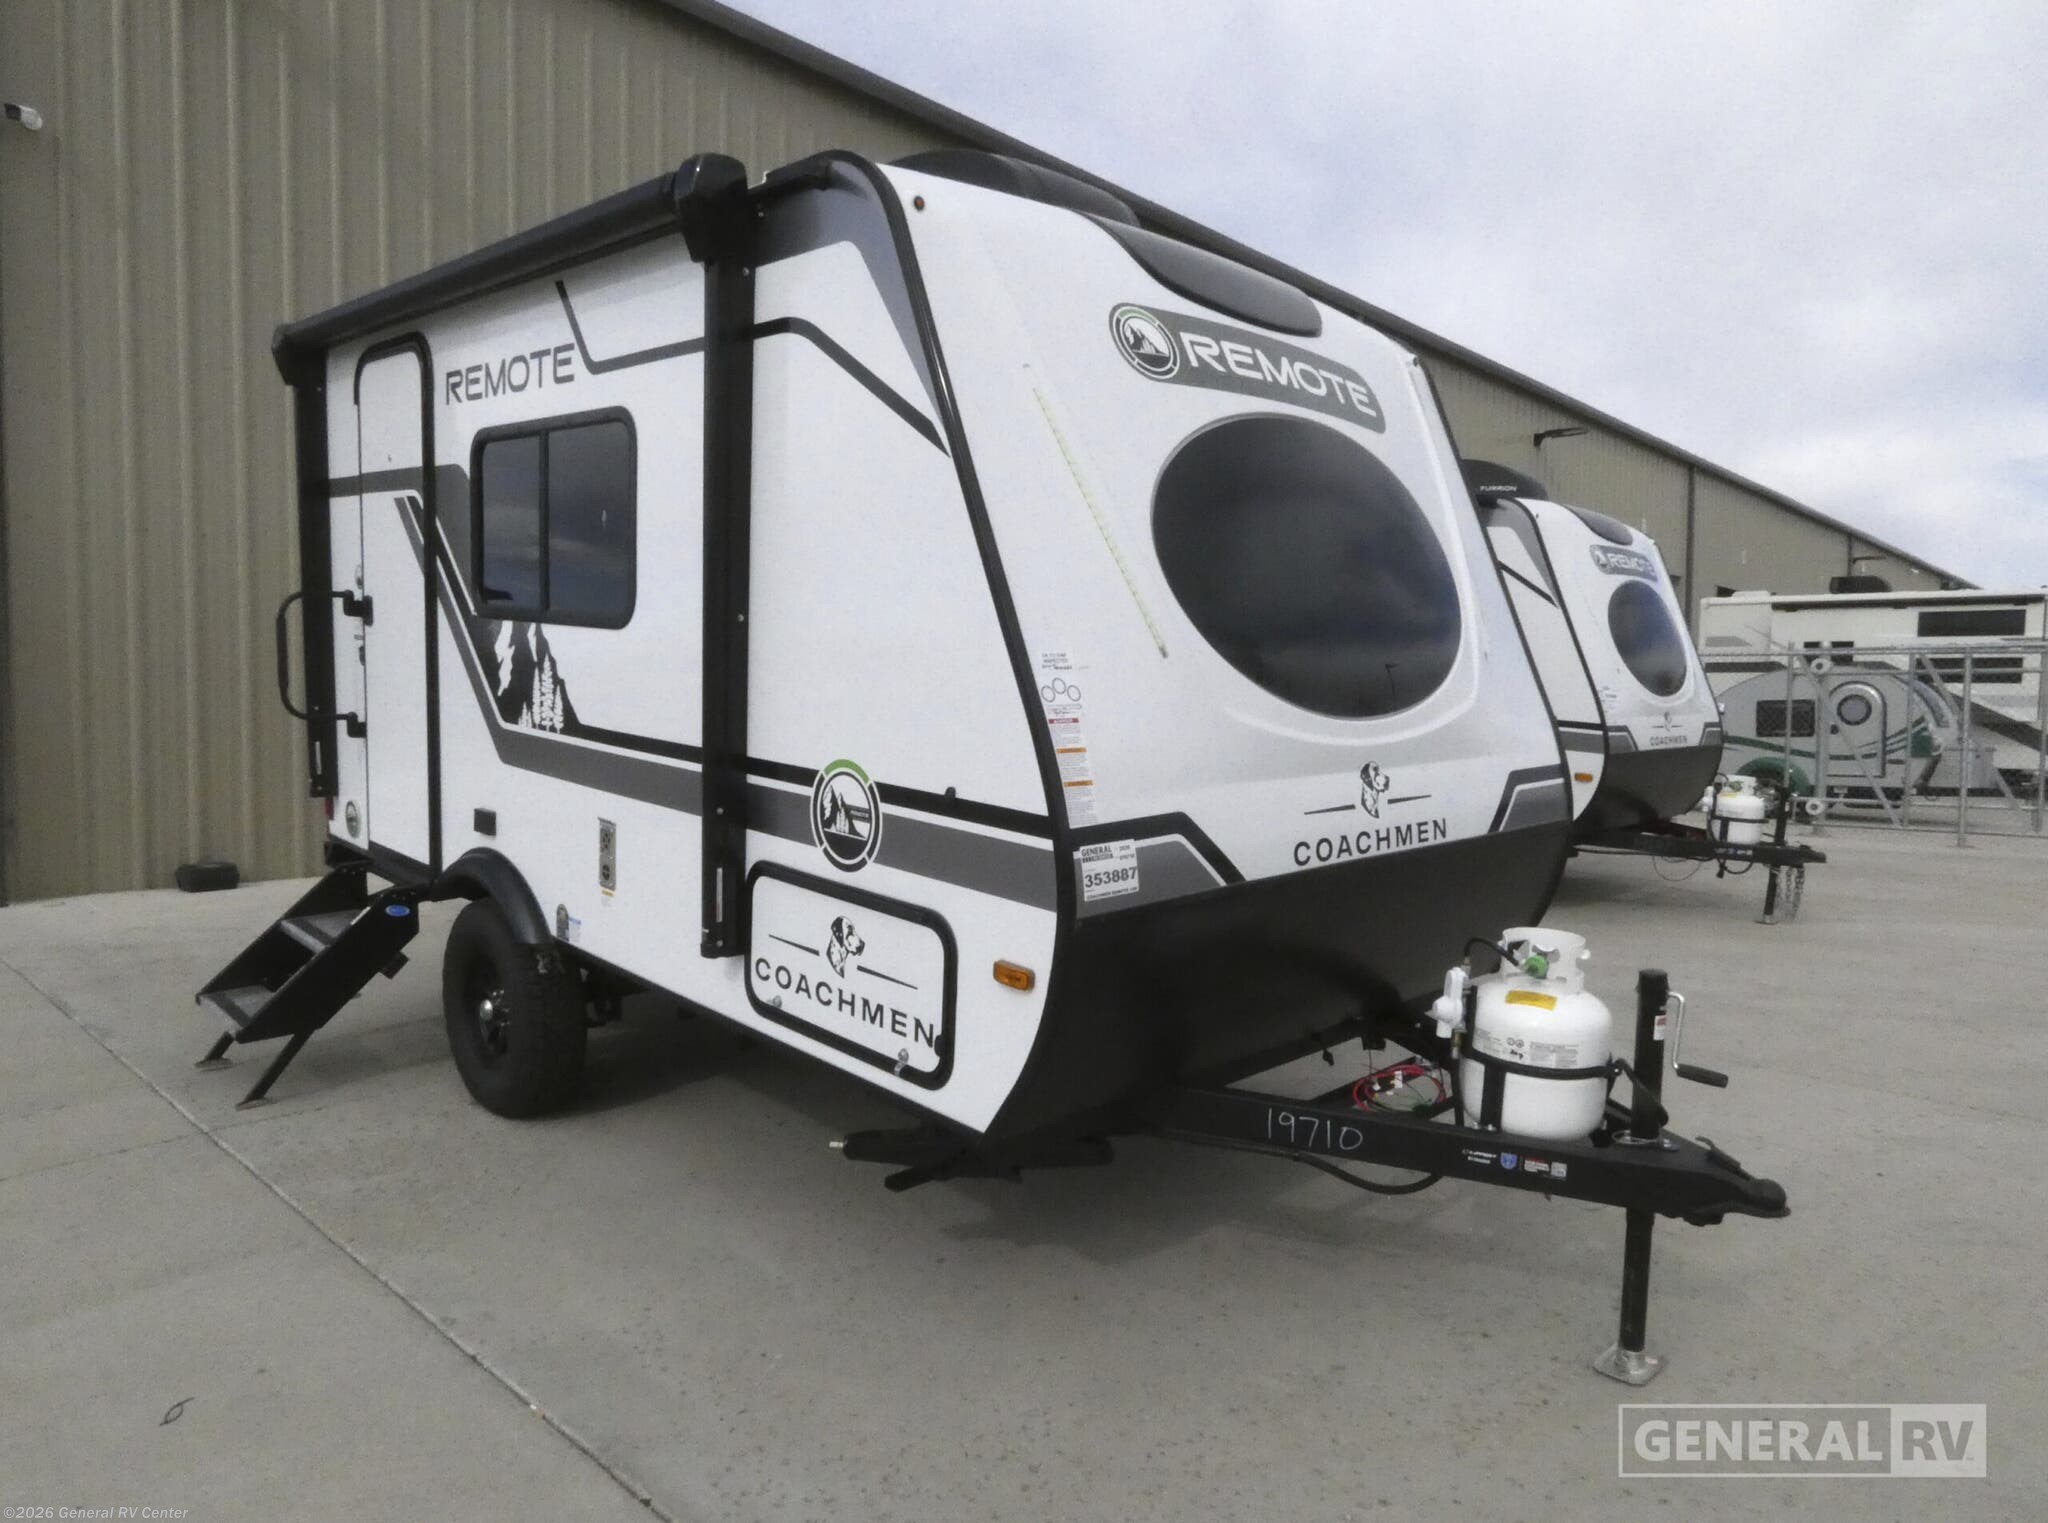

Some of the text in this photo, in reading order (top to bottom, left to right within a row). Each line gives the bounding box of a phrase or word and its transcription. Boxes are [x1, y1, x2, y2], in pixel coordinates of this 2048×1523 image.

[446, 342, 575, 405] REMOTE
[1179, 331, 1377, 417] REMOTE
[1081, 845, 1112, 857] GENERAL
[1294, 818, 1447, 866] COACHMEN
[1085, 866, 1137, 888] 353887
[755, 957, 934, 1048] COACHMEN
[1268, 1108, 1363, 1150] 19710
